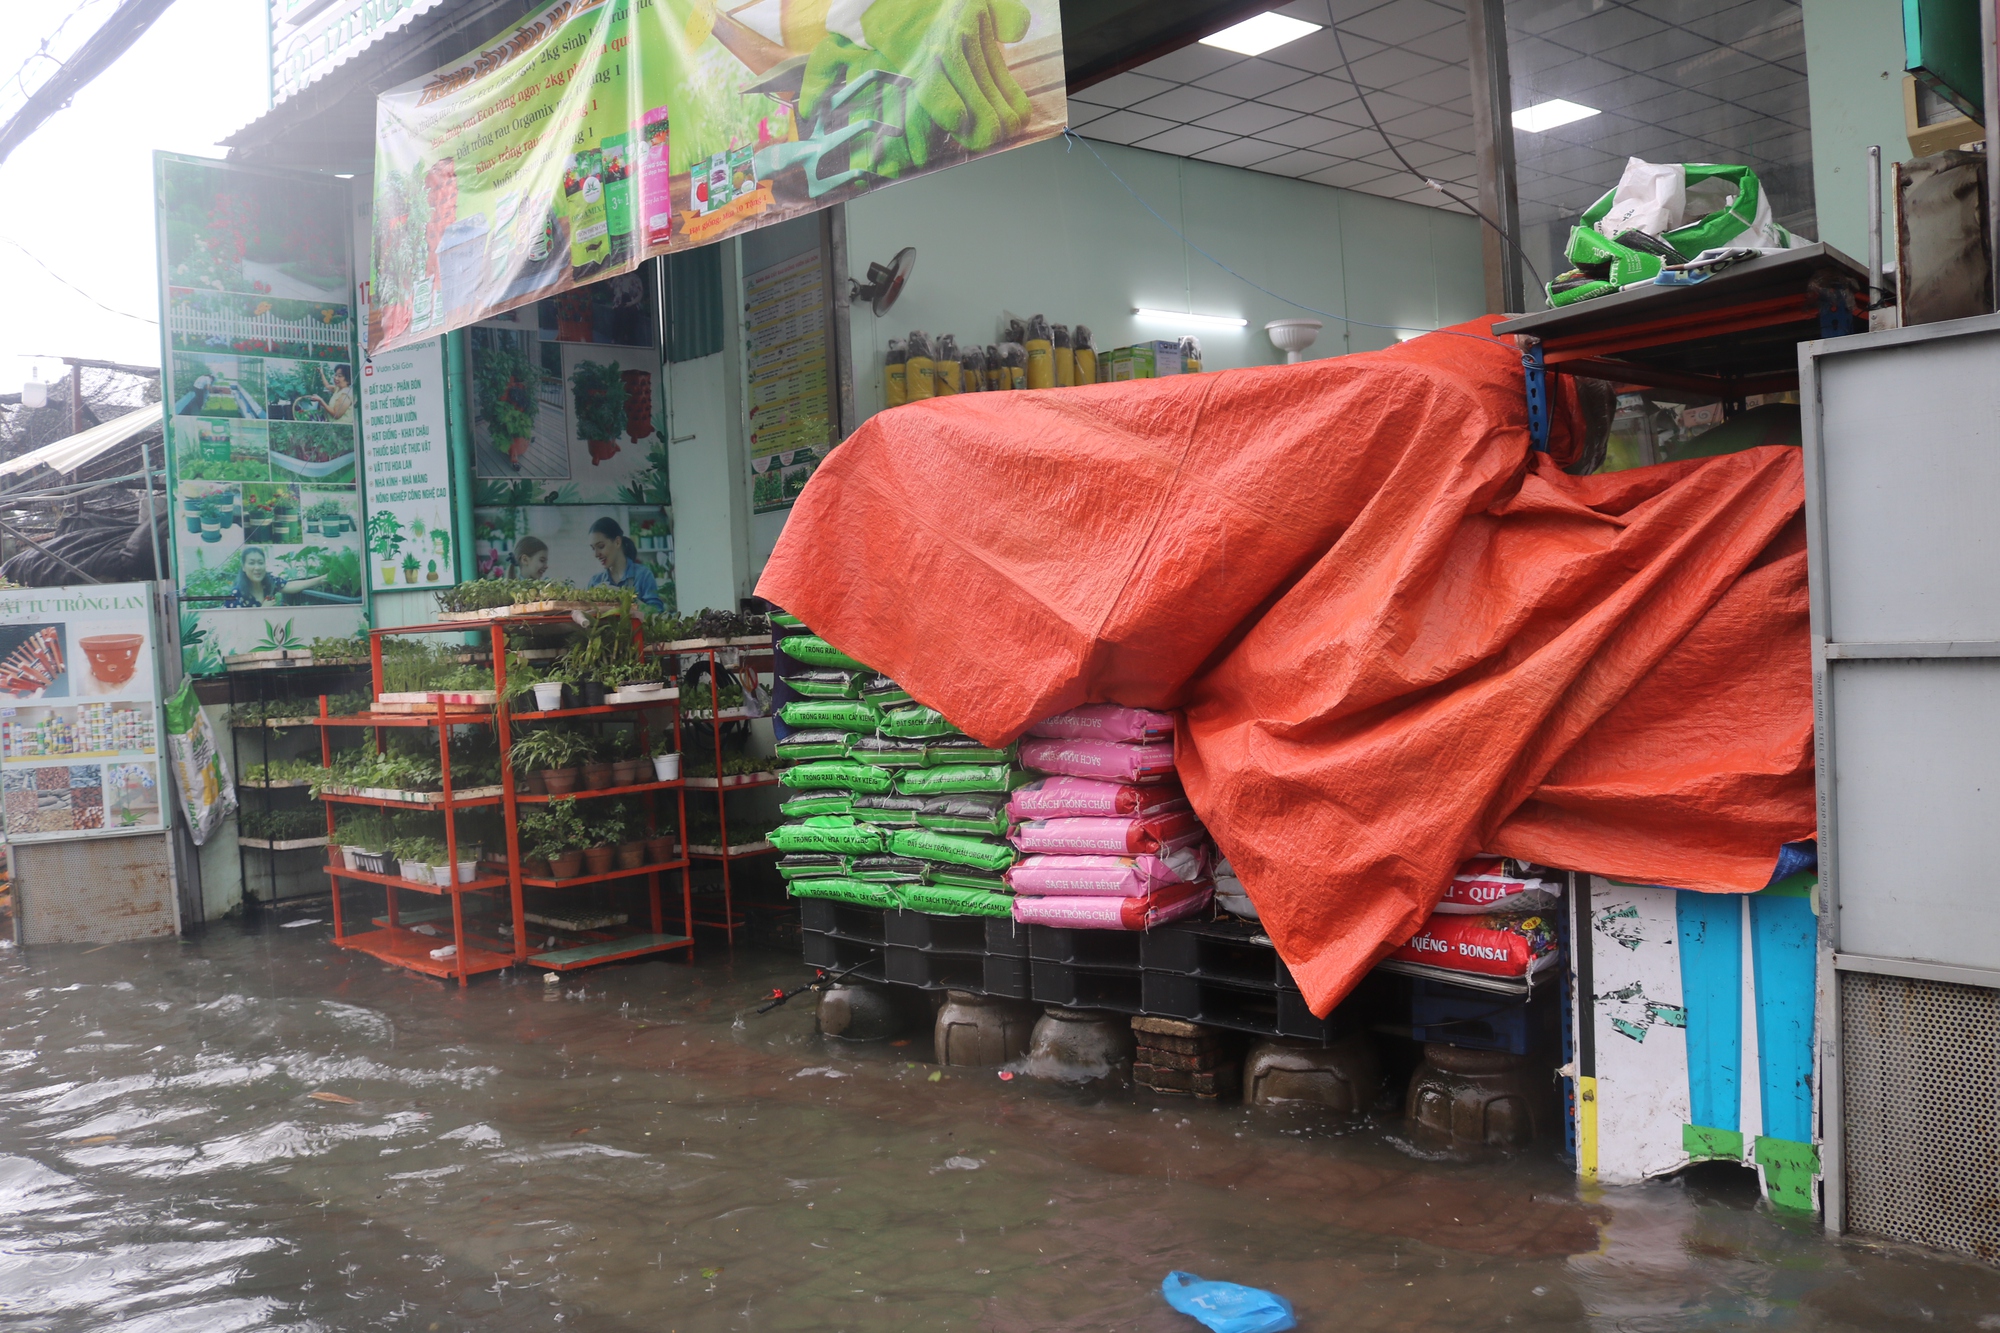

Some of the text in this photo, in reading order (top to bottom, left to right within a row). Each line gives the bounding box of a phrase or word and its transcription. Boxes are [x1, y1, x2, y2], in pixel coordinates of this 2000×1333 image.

[540, 47, 560, 64] 2kg
[562, 33, 587, 53] sinh
[477, 106, 495, 122] Eco
[495, 93, 517, 114] tặng
[517, 82, 542, 102] ngay
[544, 70, 566, 89] 2kg
[494, 123, 511, 140] rau
[512, 103, 555, 132] Orgamix
[475, 158, 496, 176] Khay
[498, 145, 523, 166] trồng
[523, 137, 540, 152] rau
[592, 99, 598, 111] 1
[492, 170, 513, 191] Muối
[369, 382, 379, 396] ĐẤT
[380, 383, 393, 396] SẠCH
[411, 377, 421, 390] BÓN
[371, 431, 382, 443] HẠT
[401, 428, 414, 438] KHAY
[421, 440, 431, 453] VẬT
[373, 461, 383, 474] VẬT
[391, 460, 402, 471] HOA
[402, 459, 412, 469] LAN
[374, 476, 385, 488] NHÀ
[401, 473, 412, 485] NHÀ
[436, 487, 446, 498] CAO
[2, 597, 22, 618] ẬT
[52, 592, 109, 612] TRỒNG
[110, 595, 145, 610] LAN
[825, 647, 837, 655] RAU
[1080, 755, 1102, 767] SẠCH
[1021, 796, 1111, 811] ĐẤT SẠCH TRỒNG CHẬU
[187, 802, 199, 830] BACK
[1025, 835, 1122, 850] ĐẤT SẠCH TRỒNG CHẬU
[1045, 879, 1069, 890] SẠCH
[1095, 878, 1120, 892] BỆNH
[1469, 884, 1507, 902] QUẢ
[913, 893, 924, 901] ĐẤT
[925, 896, 940, 905] SẠCH
[941, 897, 960, 907] TRỒNG
[978, 902, 1007, 912] ORGAMIX
[1022, 904, 1116, 922] ĐẤT SẠCH TRỒNG CHẬU
[1411, 932, 1508, 961] KIỂNG BONSAI
